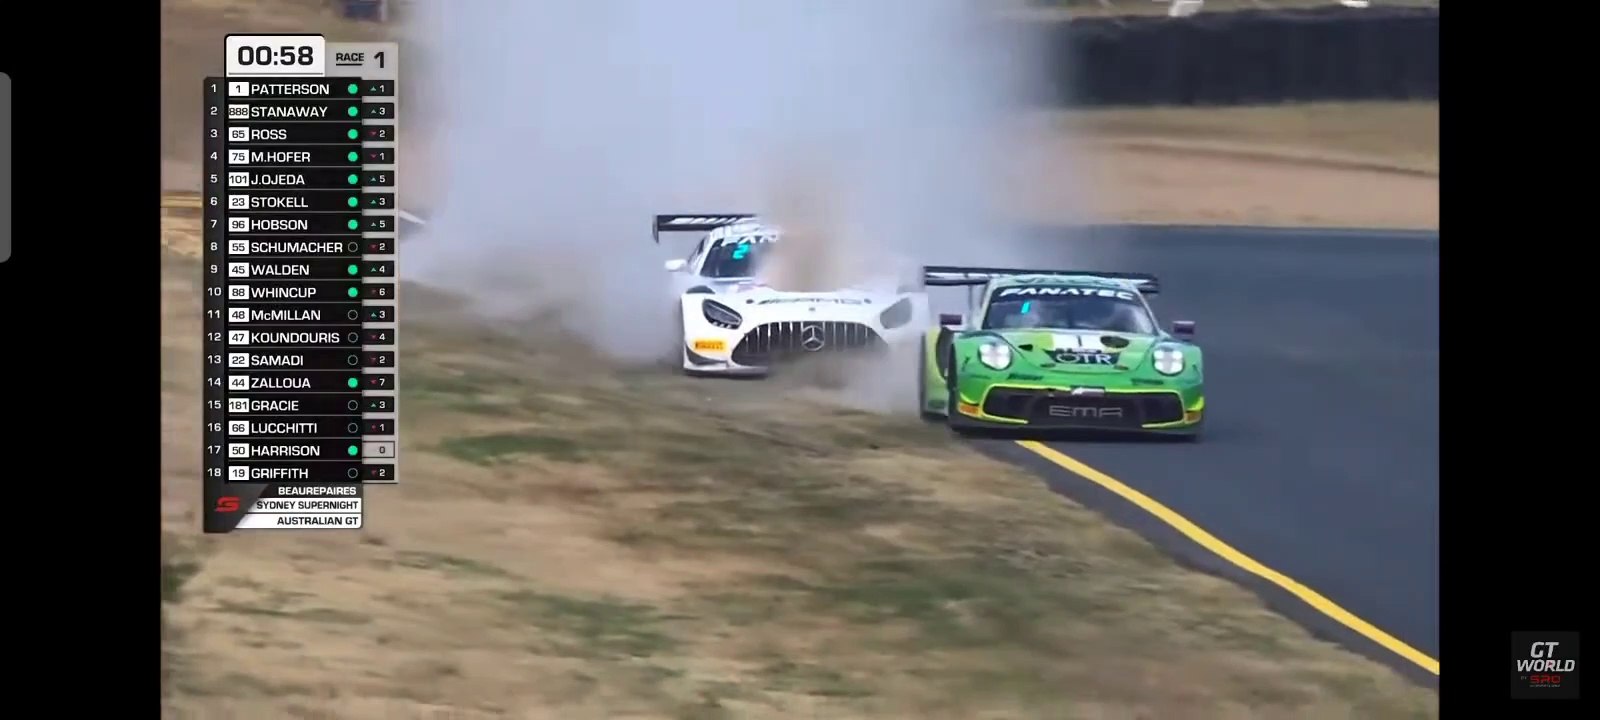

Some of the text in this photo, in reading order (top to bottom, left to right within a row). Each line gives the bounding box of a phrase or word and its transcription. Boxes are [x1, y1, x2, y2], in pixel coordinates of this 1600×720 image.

[733, 243, 750, 259] 2
[999, 287, 1134, 301] FANATEC
[1056, 353, 1112, 365] OTR
